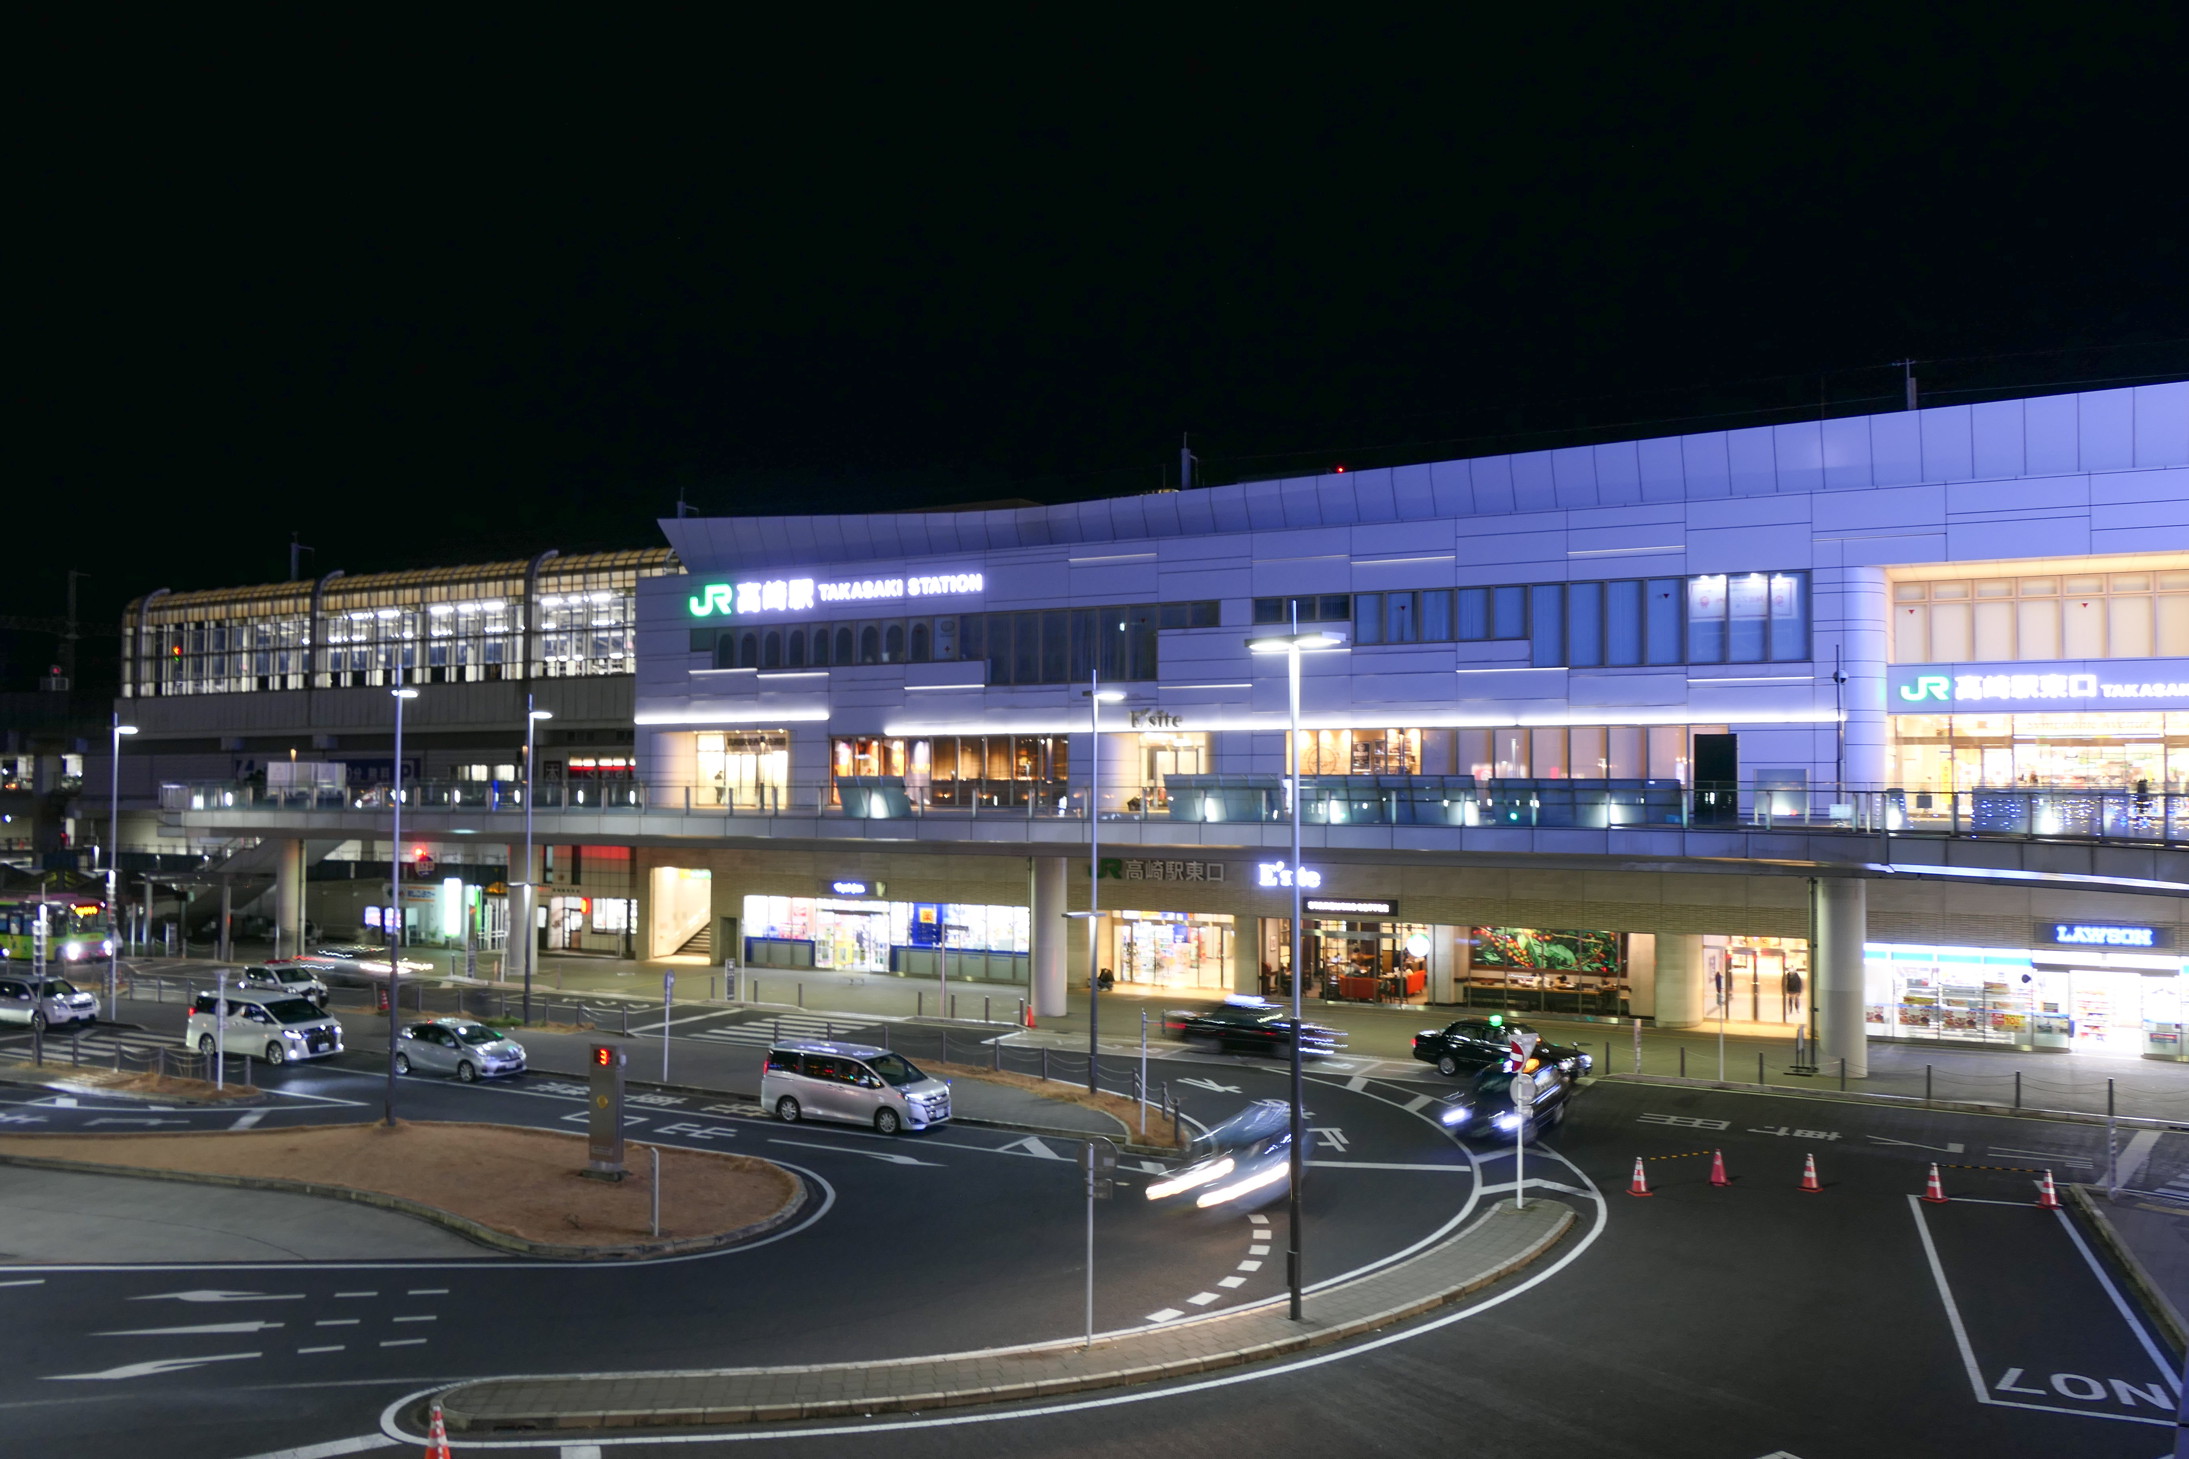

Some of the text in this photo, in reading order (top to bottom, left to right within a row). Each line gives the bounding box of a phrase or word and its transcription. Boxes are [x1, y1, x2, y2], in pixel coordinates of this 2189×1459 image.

[689, 573, 983, 616] JR 高崎駅 TAKASAKI STATION
[1900, 675, 1950, 701] JR
[1954, 673, 2098, 701] 高崎駅東口
[1125, 859, 1226, 882] 高崎駅東口
[1258, 861, 1321, 888] E'ste
[2056, 925, 2153, 946] LAWSON
